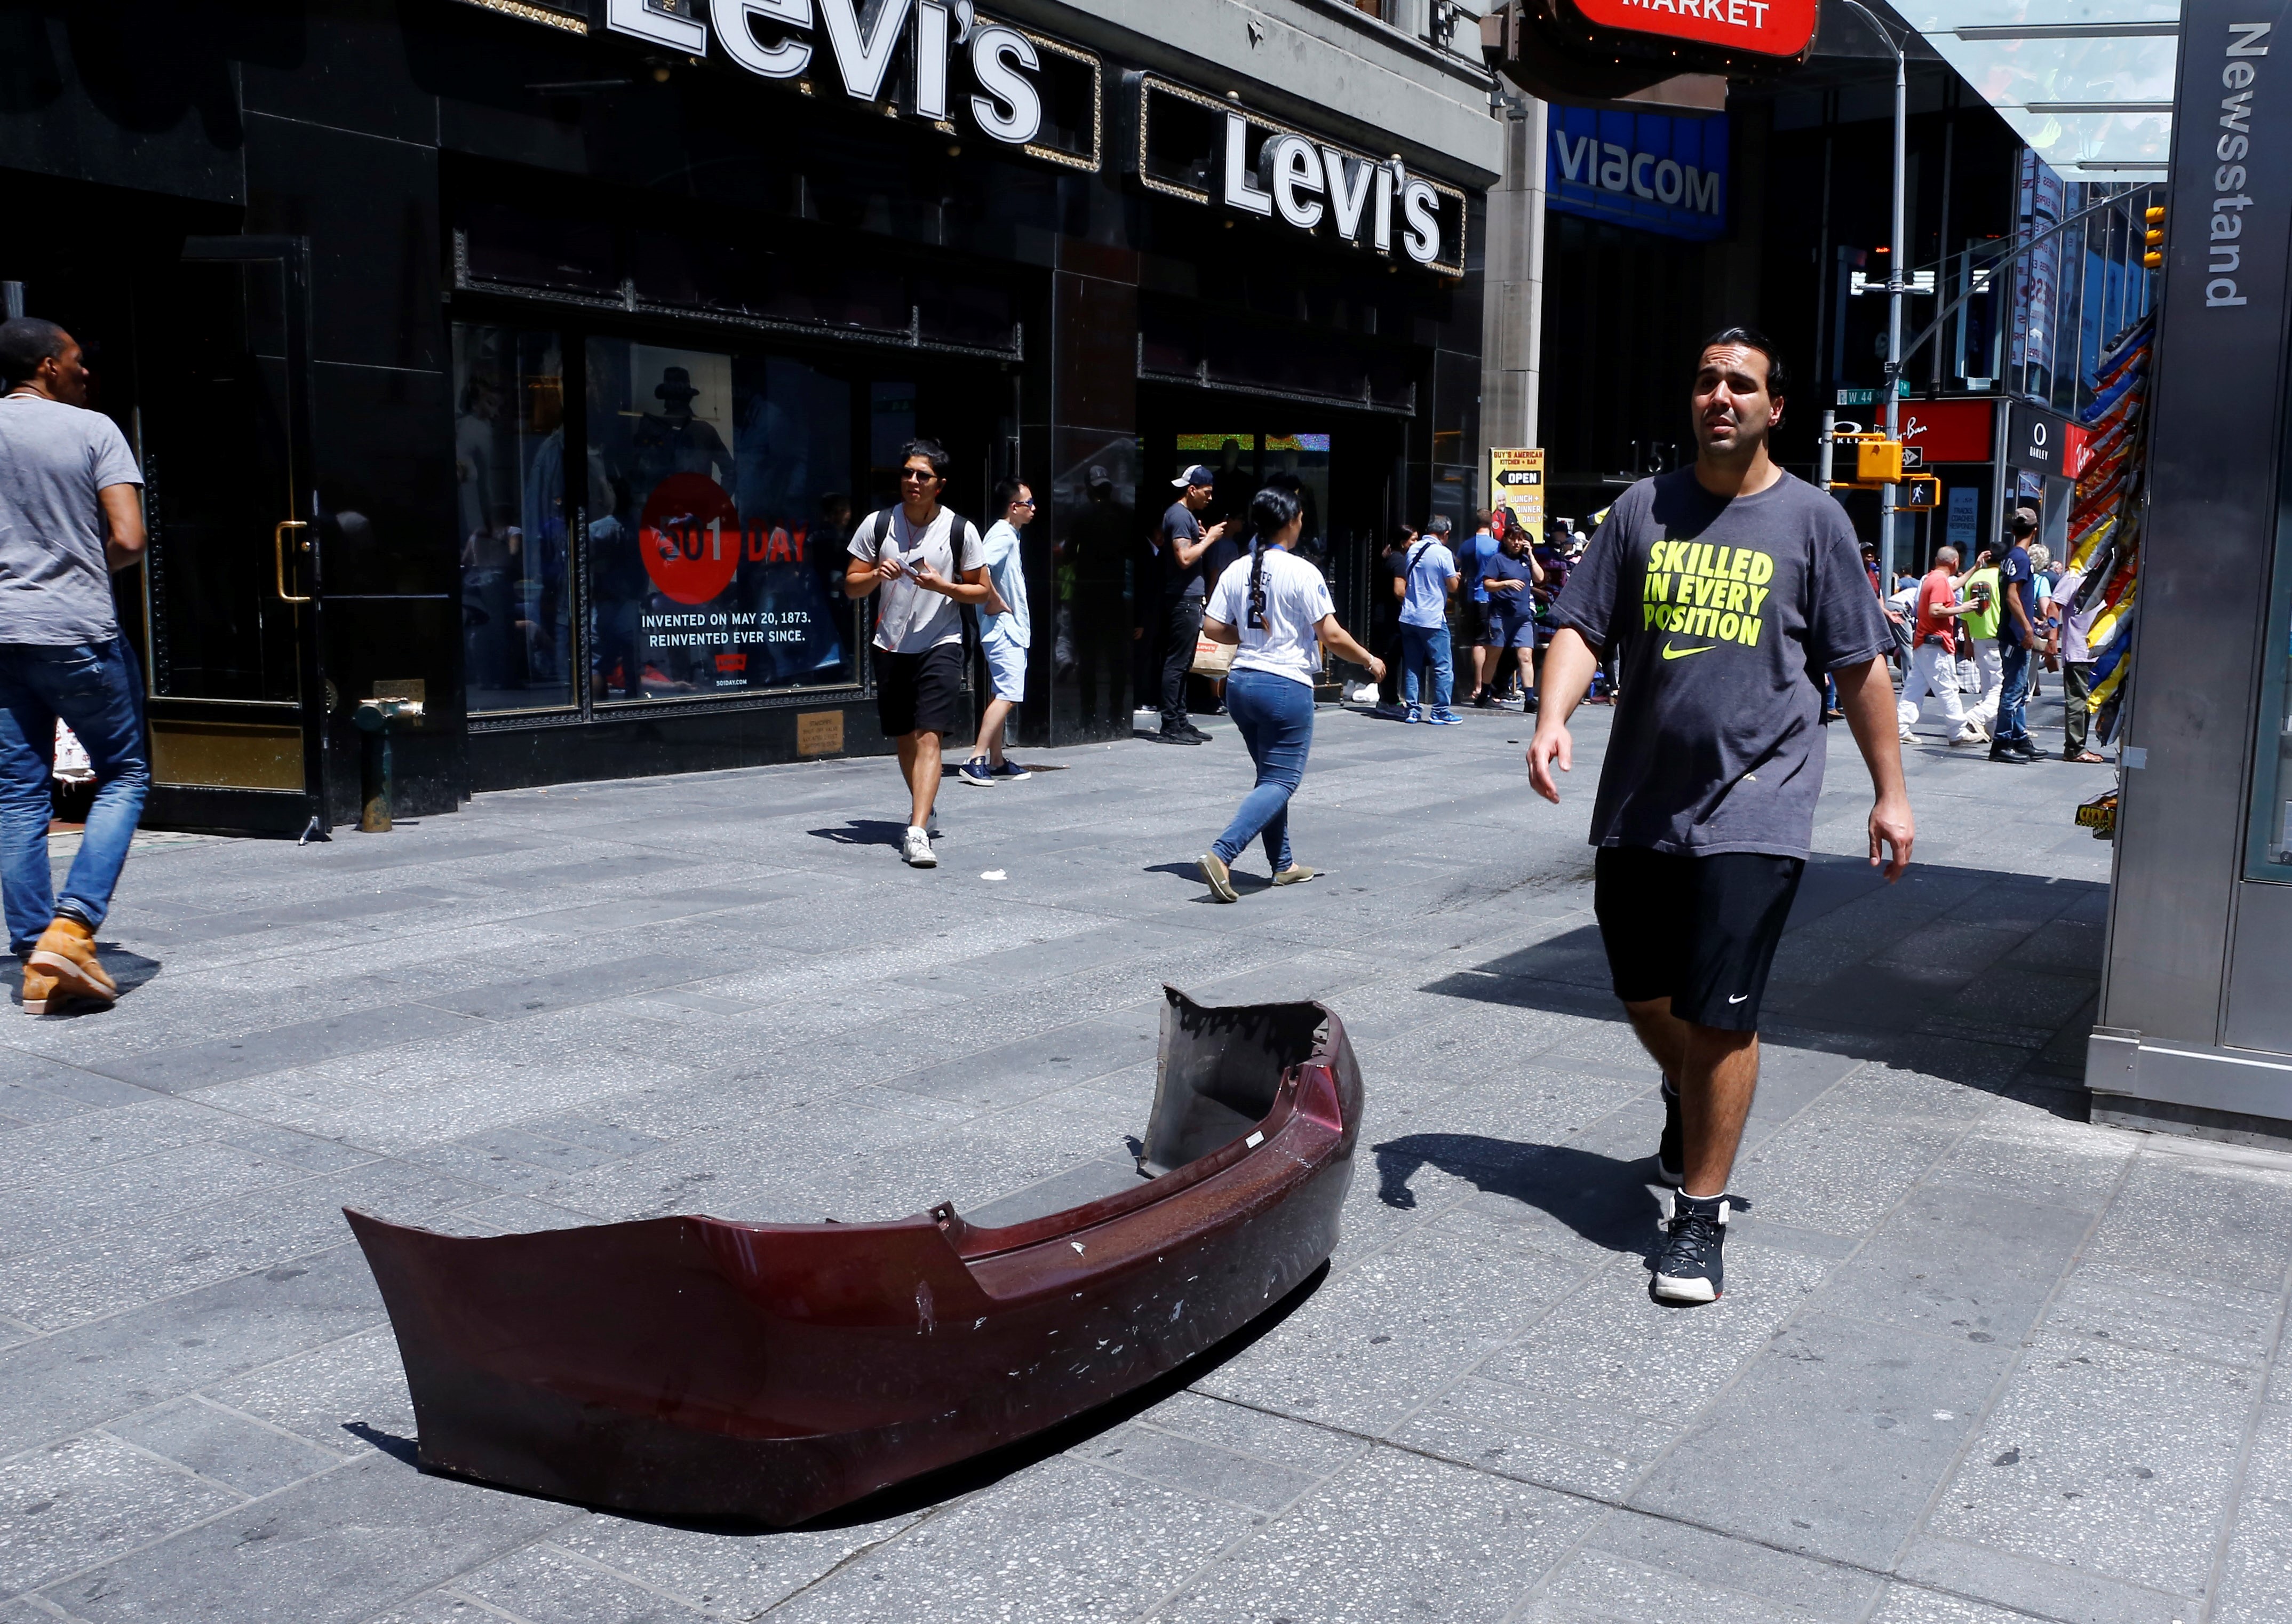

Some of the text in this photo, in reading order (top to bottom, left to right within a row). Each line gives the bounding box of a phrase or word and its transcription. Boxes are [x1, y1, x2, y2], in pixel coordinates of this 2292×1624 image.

[2206, 22, 2271, 307] Newsstand
[1224, 111, 1439, 263] Levi's
[1849, 392, 1857, 403] W
[1861, 391, 1872, 402] 44
[2030, 446, 2049, 460] OAKLEY
[1508, 472, 1537, 484] OPEN
[659, 516, 809, 562] 501 DAY
[1244, 572, 1272, 586] JER
[1647, 540, 1774, 585] SKILLED
[1247, 590, 1266, 628] 2
[1643, 572, 1770, 616] IN EVERY
[642, 611, 811, 627] INVENTED ON MAY 20, 1873.
[1643, 603, 1763, 647] POSITION
[649, 630, 806, 647] REINVENTED EVER SINCE.
